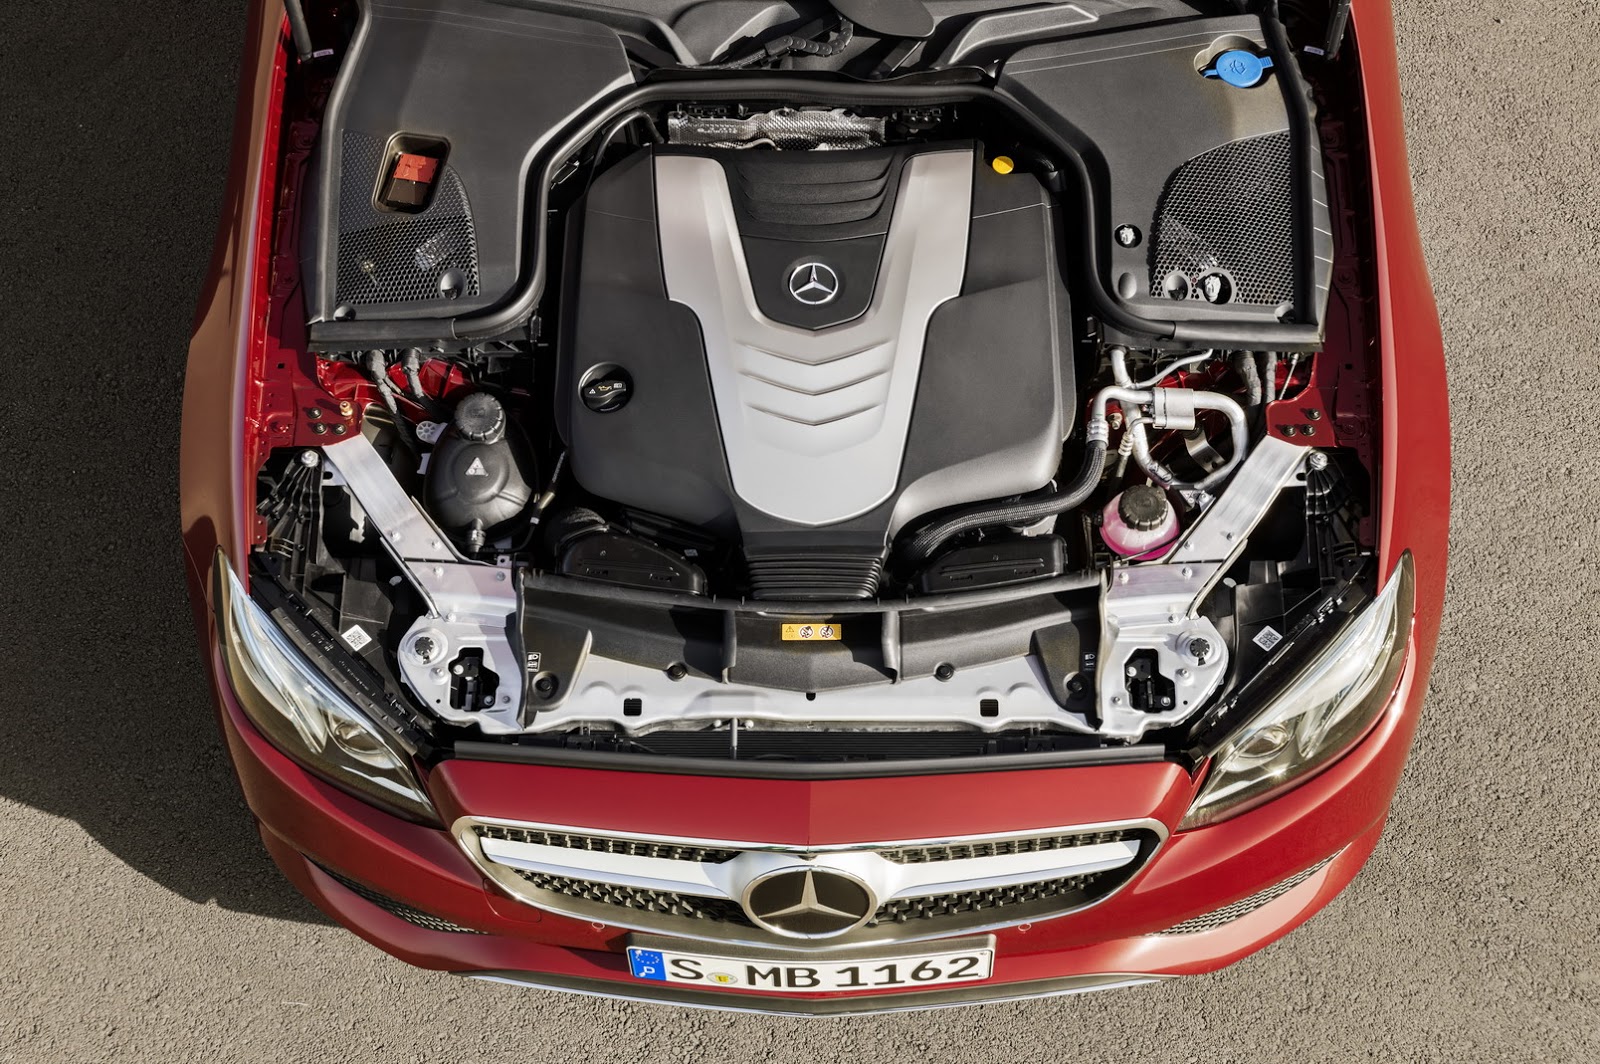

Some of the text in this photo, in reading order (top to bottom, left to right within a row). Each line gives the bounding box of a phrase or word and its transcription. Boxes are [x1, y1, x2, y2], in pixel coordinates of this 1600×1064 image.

[643, 956, 980, 988] D S MB 1162
